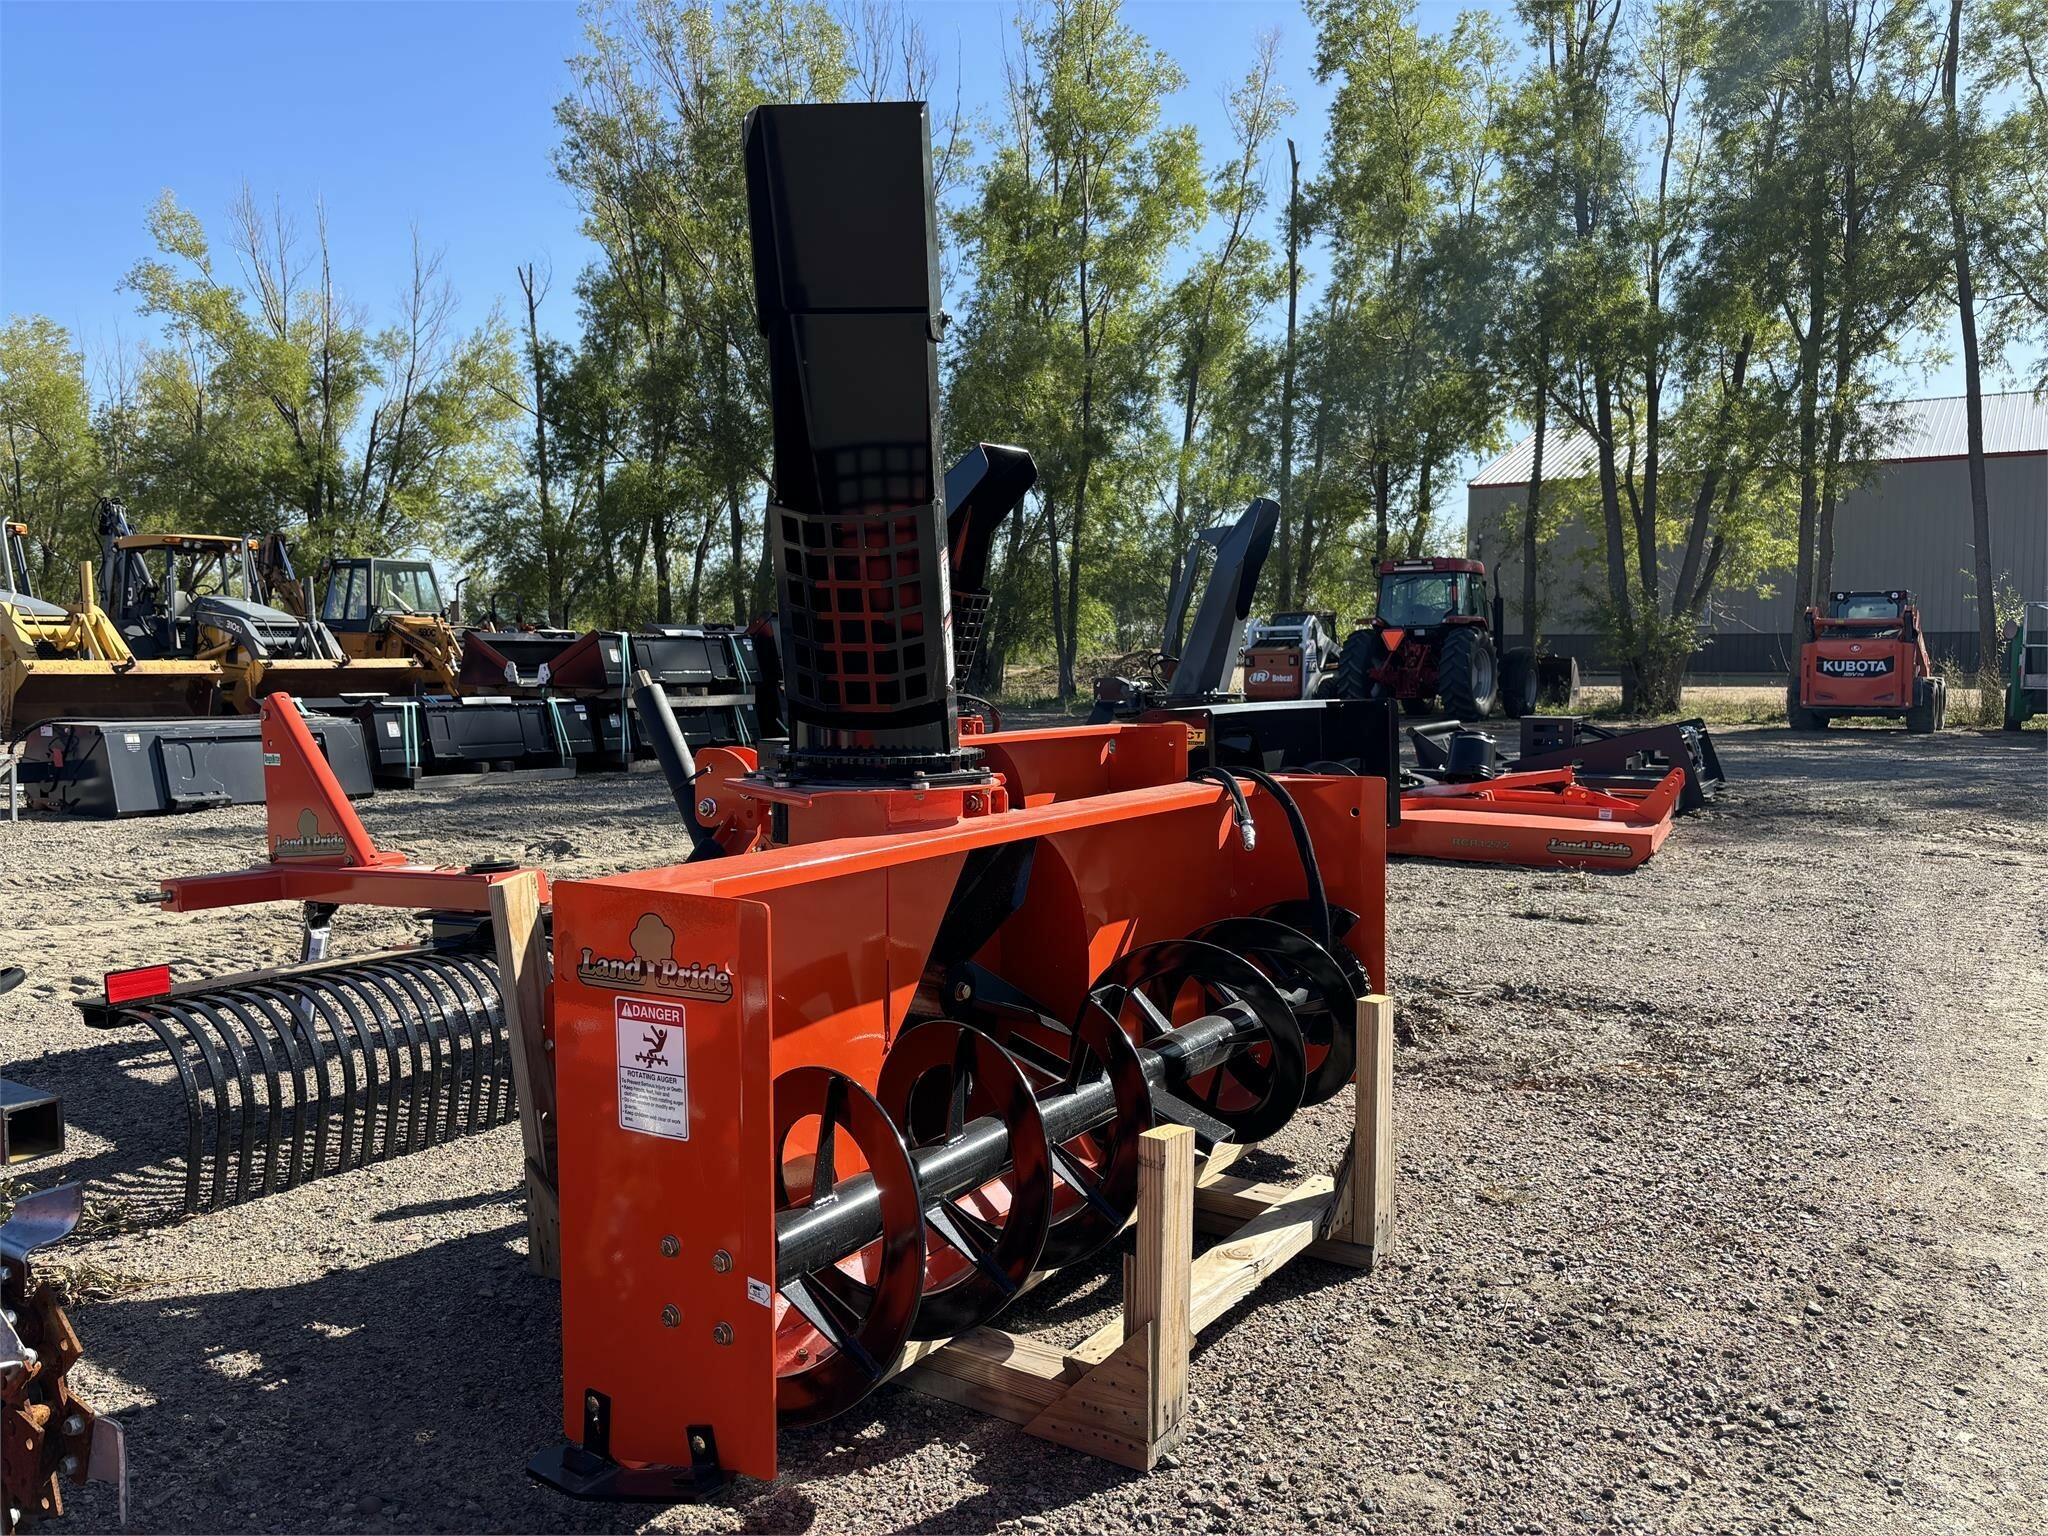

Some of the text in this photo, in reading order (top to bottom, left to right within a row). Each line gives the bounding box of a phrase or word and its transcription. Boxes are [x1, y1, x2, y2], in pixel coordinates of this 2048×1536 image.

[225, 619, 243, 634] 310SJ
[1823, 660, 1887, 672] KUBOTA
[1272, 674, 1293, 683] Bobcat
[277, 832, 344, 848] Land Pride
[1549, 838, 1631, 852] Land Pride
[579, 948, 731, 993] Land Pride
[632, 1004, 680, 1022] DANGER
[627, 1069, 677, 1084] ROTATING AUGER
